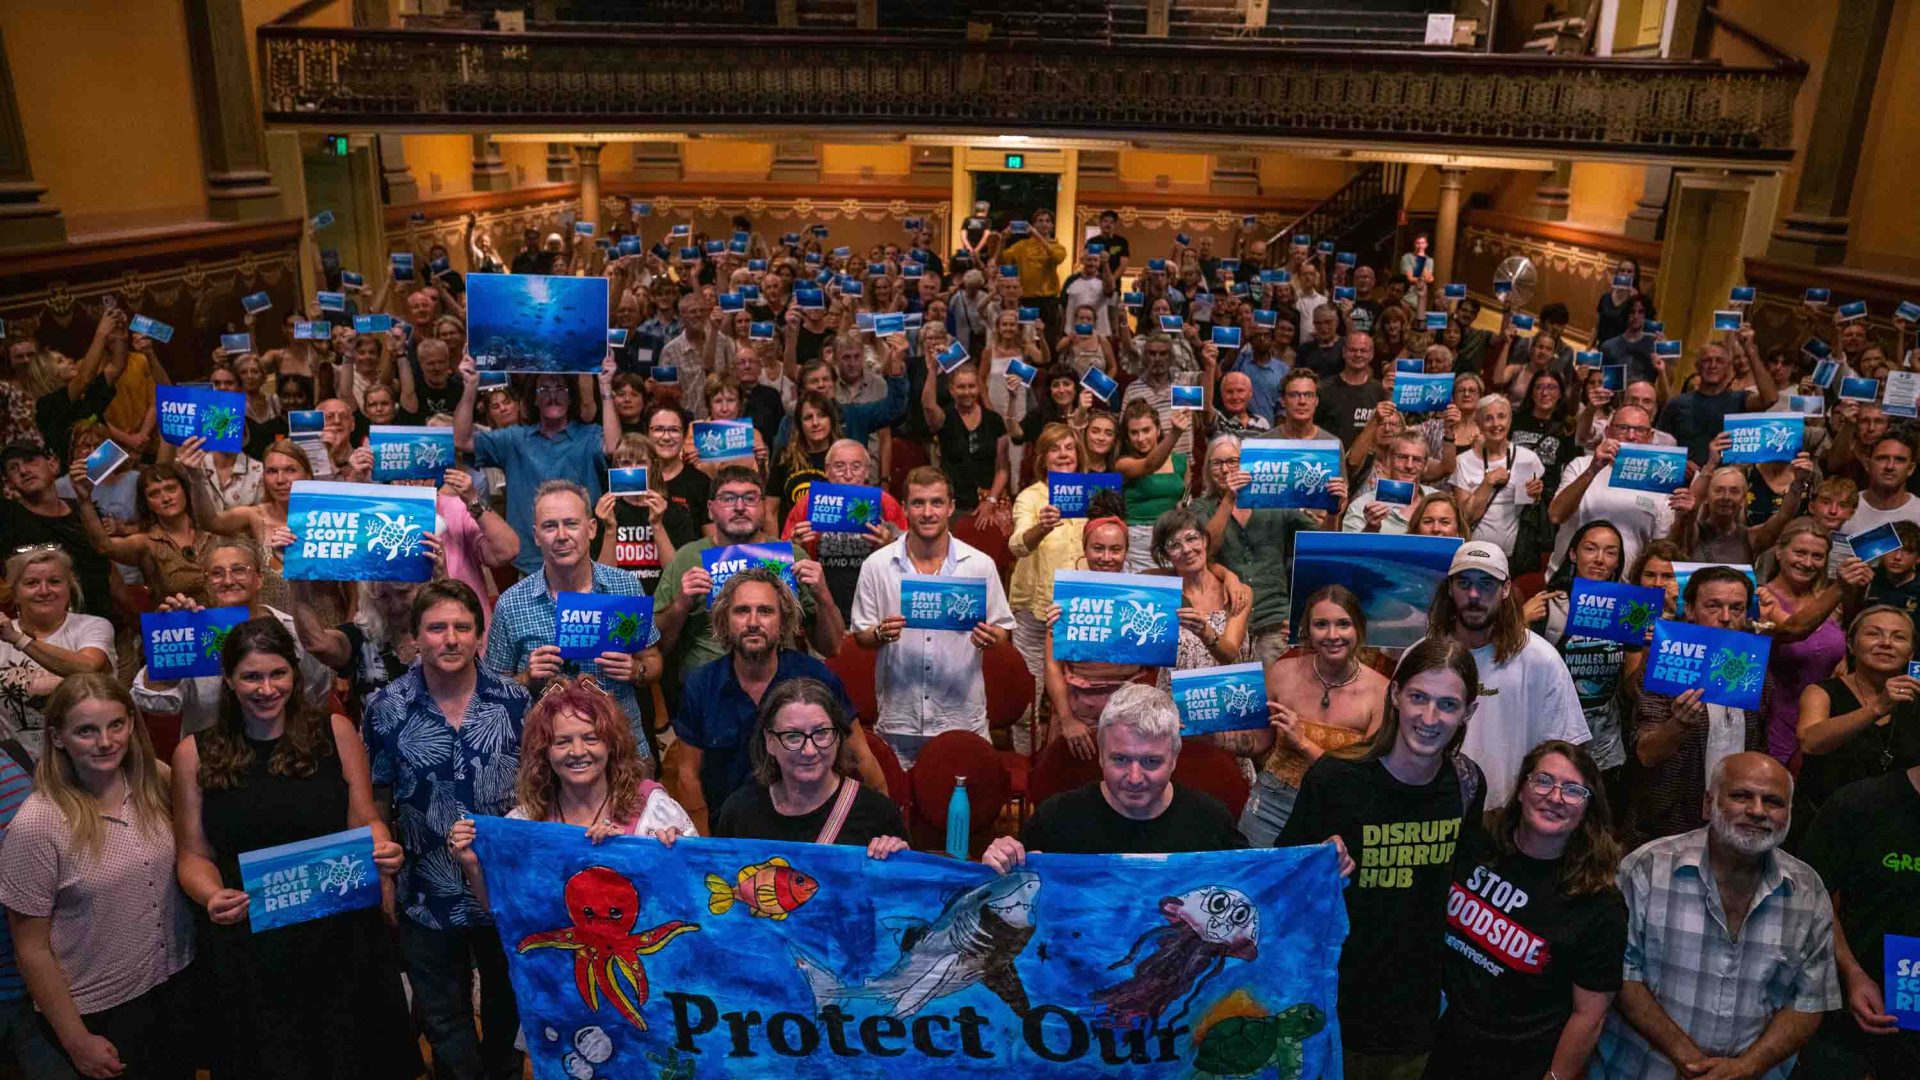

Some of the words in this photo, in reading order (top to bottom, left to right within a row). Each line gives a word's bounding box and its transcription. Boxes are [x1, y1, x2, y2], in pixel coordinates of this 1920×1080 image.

[1403, 384, 1424, 392] SAVE
[161, 401, 197, 416] SAVE
[163, 413, 195, 425] SCOTT
[163, 423, 195, 438] REEF
[1733, 427, 1761, 437] SAVE
[380, 442, 410, 453] SAVE
[1732, 443, 1760, 453] REEF
[380, 452, 410, 461] SCOTT
[1623, 457, 1649, 468] SAVE
[381, 461, 410, 470] REEF
[1253, 461, 1290, 474] SAVE
[1622, 465, 1647, 473] SCOTT
[1253, 474, 1288, 482] SCOTT
[1619, 472, 1647, 481] REEF
[1053, 485, 1083, 495] SAVE
[1250, 482, 1287, 495] REEF
[814, 494, 844, 506] SAVE
[1053, 495, 1083, 503] SCOTT
[813, 505, 842, 514] SCOTT
[305, 511, 360, 529] SAVE
[811, 513, 842, 524] REEF
[305, 528, 358, 541] SCOTT
[302, 541, 357, 559] REEF
[711, 559, 747, 575] SAVE
[913, 591, 942, 602] SAVE
[1577, 593, 1617, 610] SAVE
[912, 601, 941, 609] SCOTT
[1069, 597, 1115, 614] SAVE
[1576, 605, 1614, 618] SCOTT
[561, 609, 602, 624] SAVE
[911, 609, 942, 620] REEF
[1068, 613, 1112, 626] SCOTT
[560, 623, 600, 634] SCOTT
[1573, 614, 1612, 630] REEF
[152, 627, 195, 644] SAVE
[1066, 625, 1112, 643] REEF
[559, 634, 600, 648] REEF
[153, 642, 194, 654] SCOTT
[1659, 639, 1707, 660] SAVE
[153, 652, 198, 669] REEF
[1657, 654, 1703, 670] SCOTT
[1652, 664, 1701, 686] REEF
[1184, 686, 1217, 702] SAVE
[1186, 698, 1218, 710] SCOTT
[1188, 707, 1220, 721] REEF
[1362, 817, 1462, 846] DISRUPT
[1361, 841, 1456, 867] BURRUP
[262, 864, 309, 888] SAVE
[1359, 867, 1413, 888] HUB
[263, 878, 309, 897] SCOTT
[1466, 865, 1529, 914] STOP
[265, 889, 312, 912] REEF
[1447, 886, 1545, 966] OODSIDE
[664, 991, 996, 1060] Protect
[1022, 1003, 1189, 1065] Our
